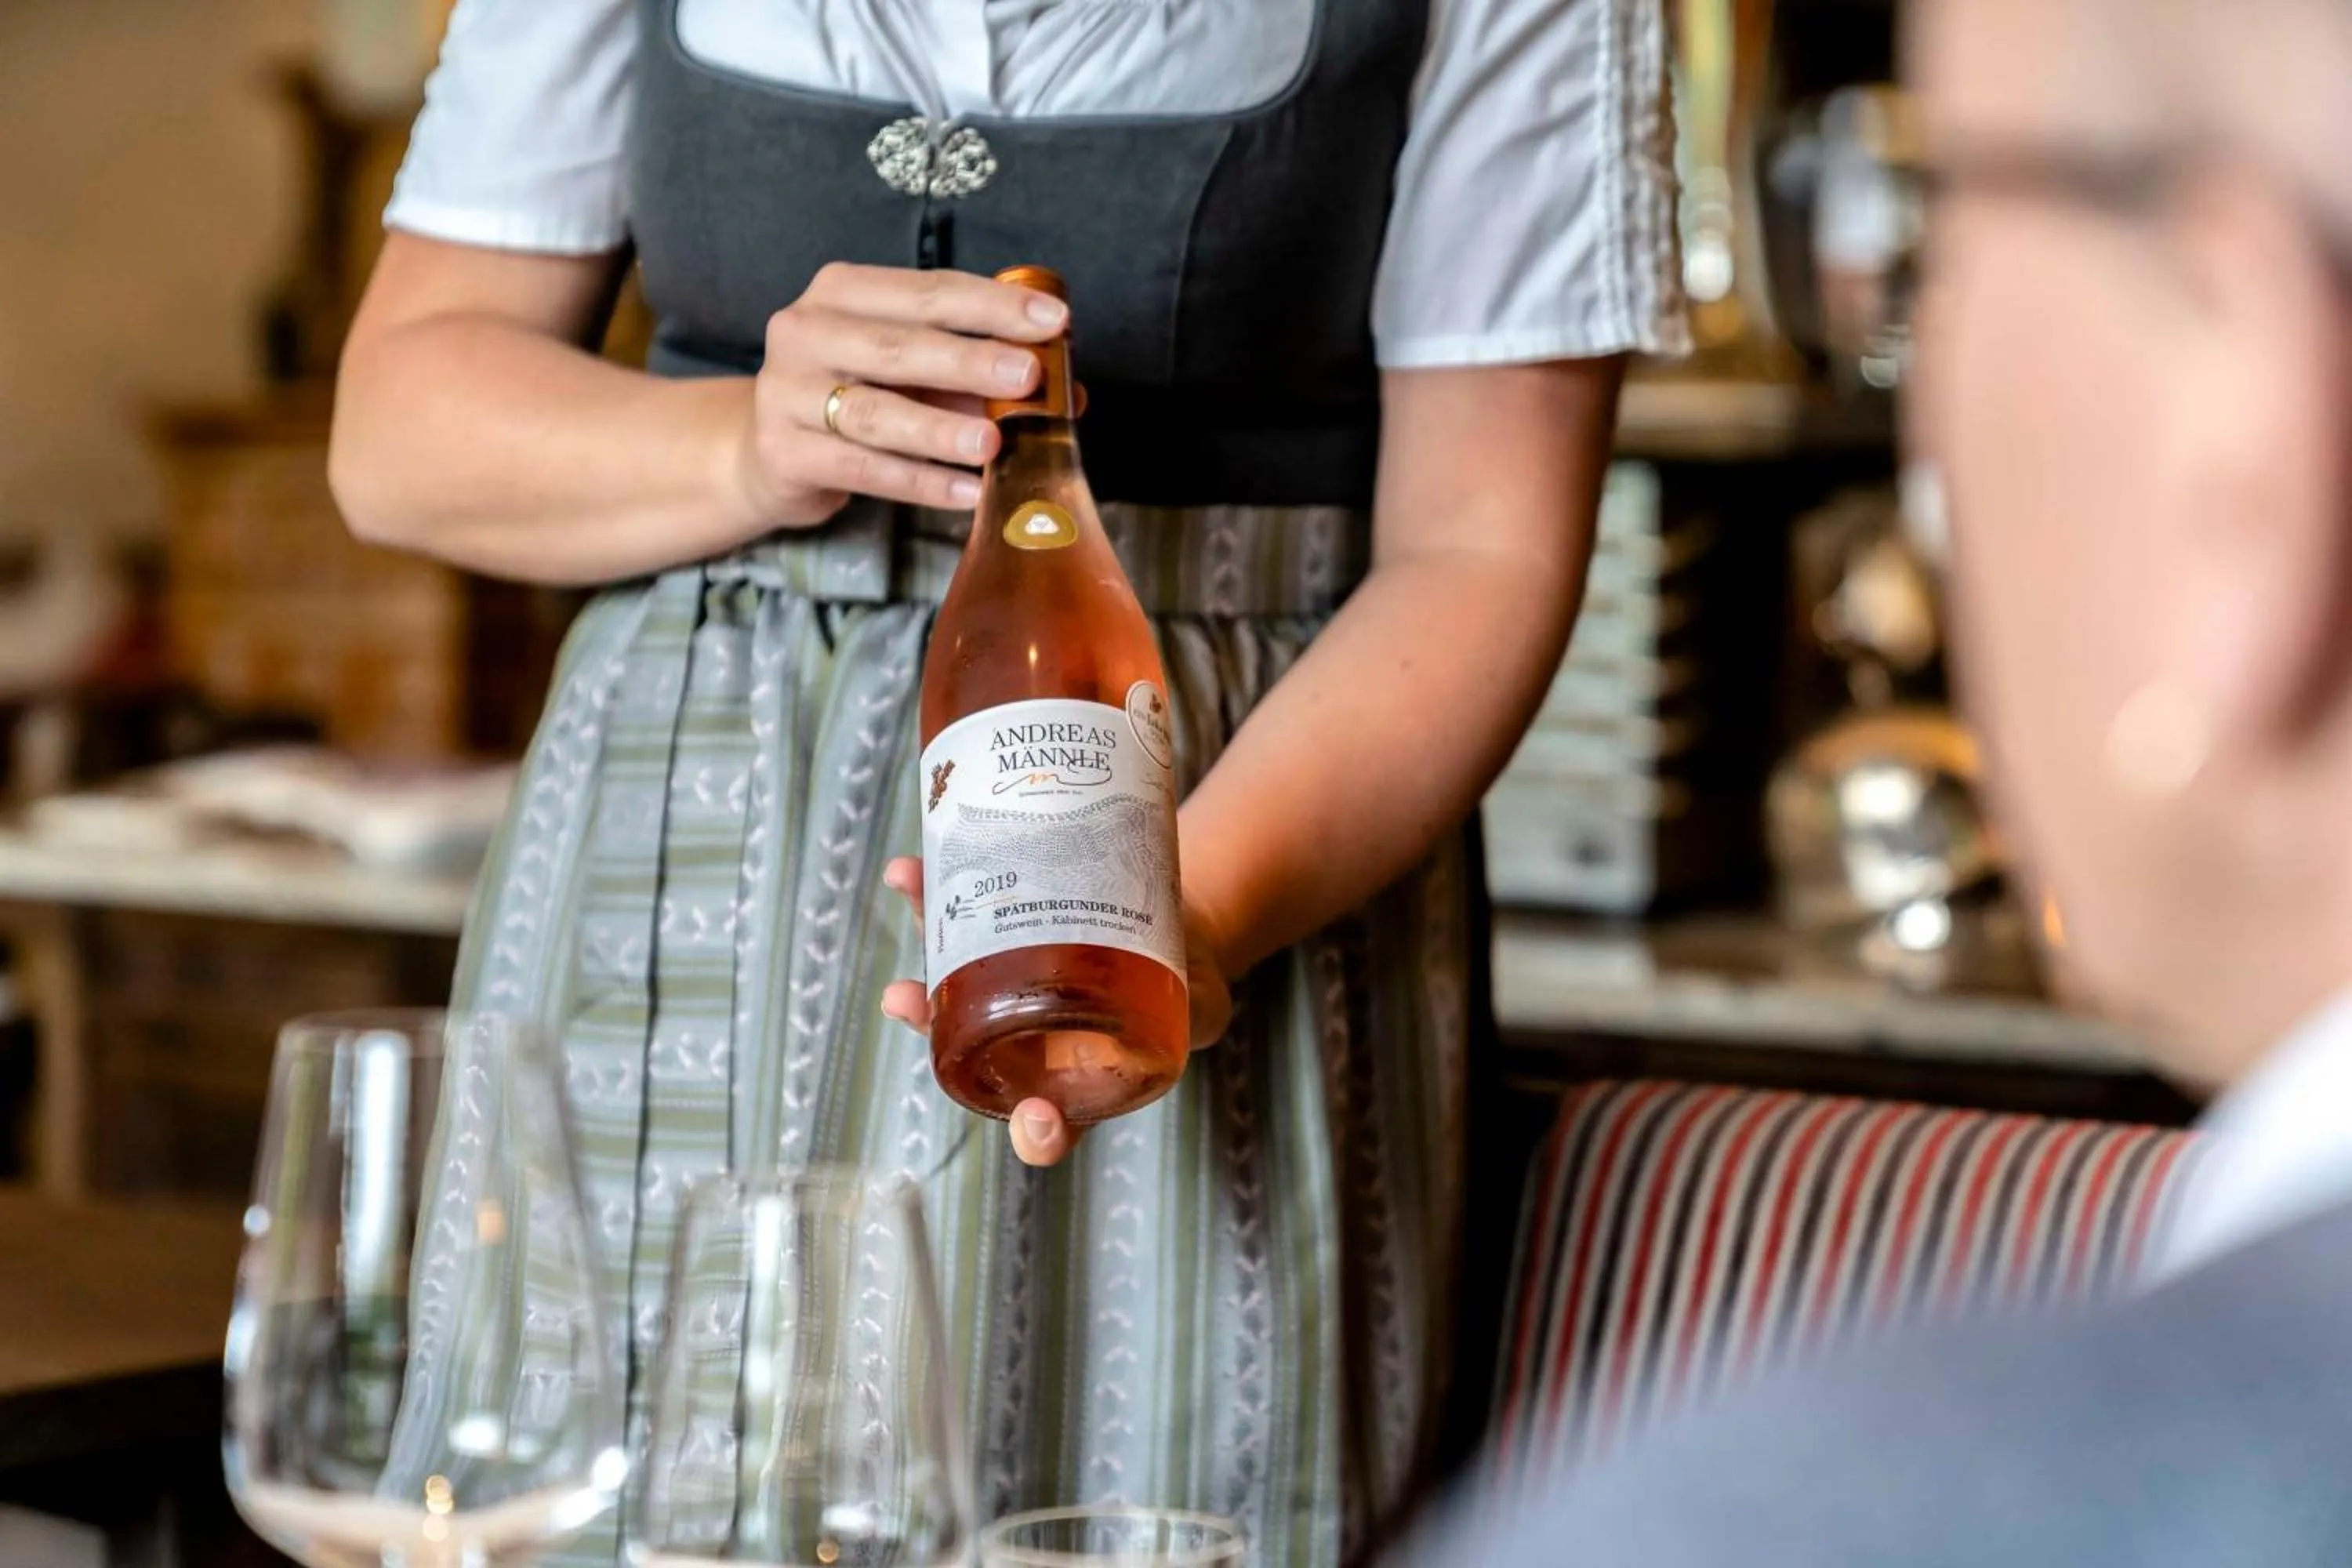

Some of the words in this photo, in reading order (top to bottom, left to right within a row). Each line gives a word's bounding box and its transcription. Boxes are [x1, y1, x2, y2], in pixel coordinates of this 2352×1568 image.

[991, 723, 1116, 750] ANDREAS
[998, 746, 1110, 771] MÄNNLE
[975, 871, 1018, 898] 2019
[993, 899, 1118, 919] SPÄTBURGUNDER
[994, 918, 1043, 934] Gutswein
[1052, 915, 1098, 926] Kabinett
[1100, 918, 1136, 935] trocken
